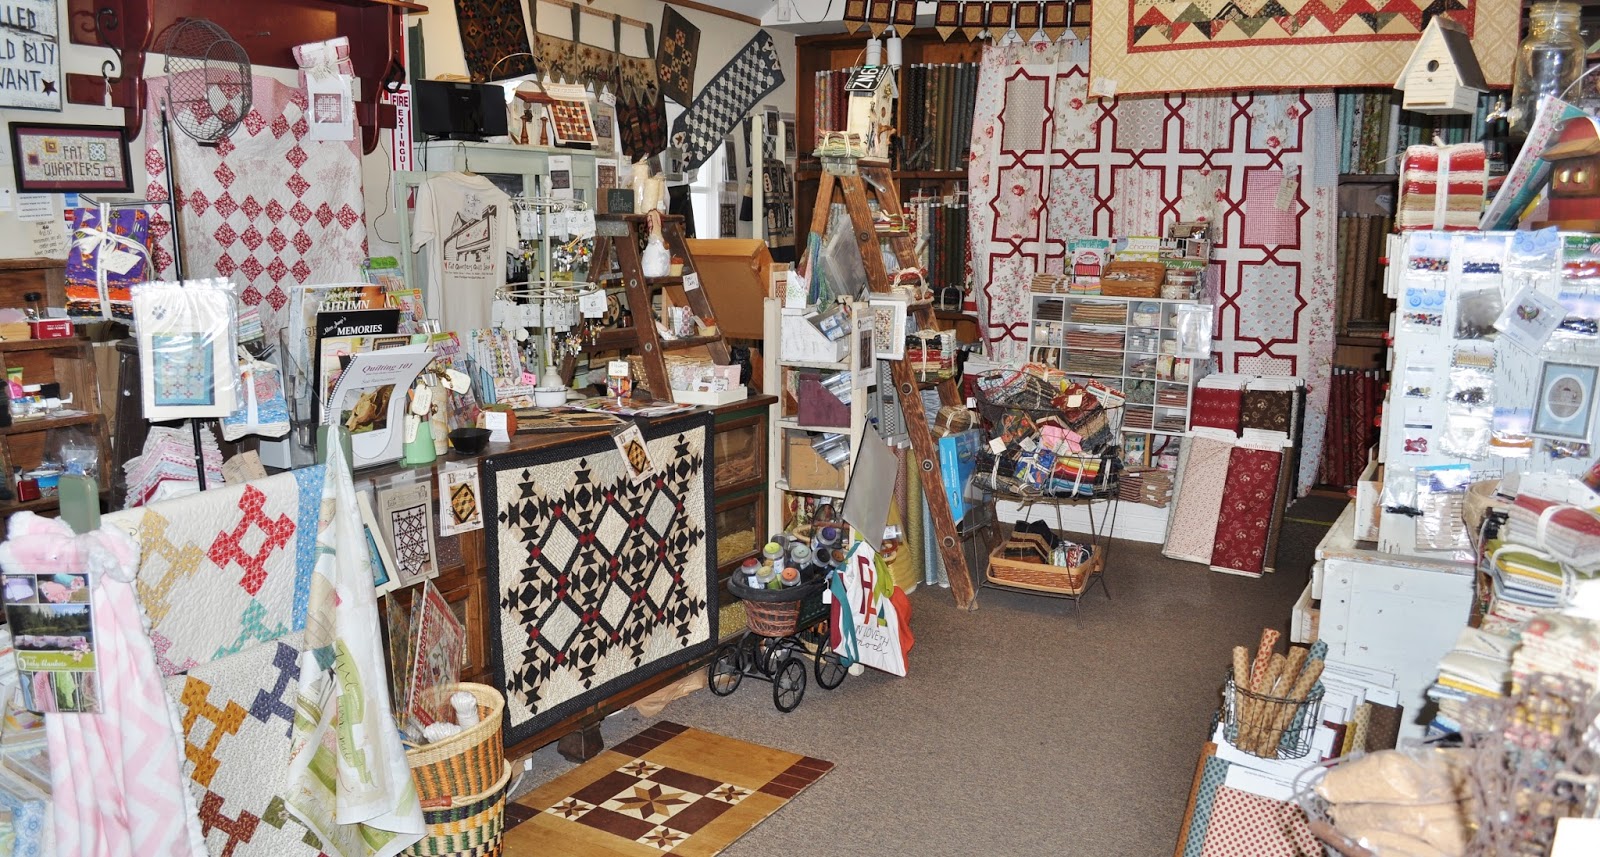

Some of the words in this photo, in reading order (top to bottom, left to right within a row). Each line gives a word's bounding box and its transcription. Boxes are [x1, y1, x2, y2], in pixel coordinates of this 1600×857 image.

[23, 41, 54, 64] BUY
[392, 95, 408, 107] FIRE
[63, 146, 82, 160] FAT
[43, 163, 101, 177] QUARTERS
[315, 299, 370, 314] AUTUMN
[337, 324, 383, 336] MEMORIES
[362, 364, 396, 373] Quilting
[398, 362, 412, 370] 101
